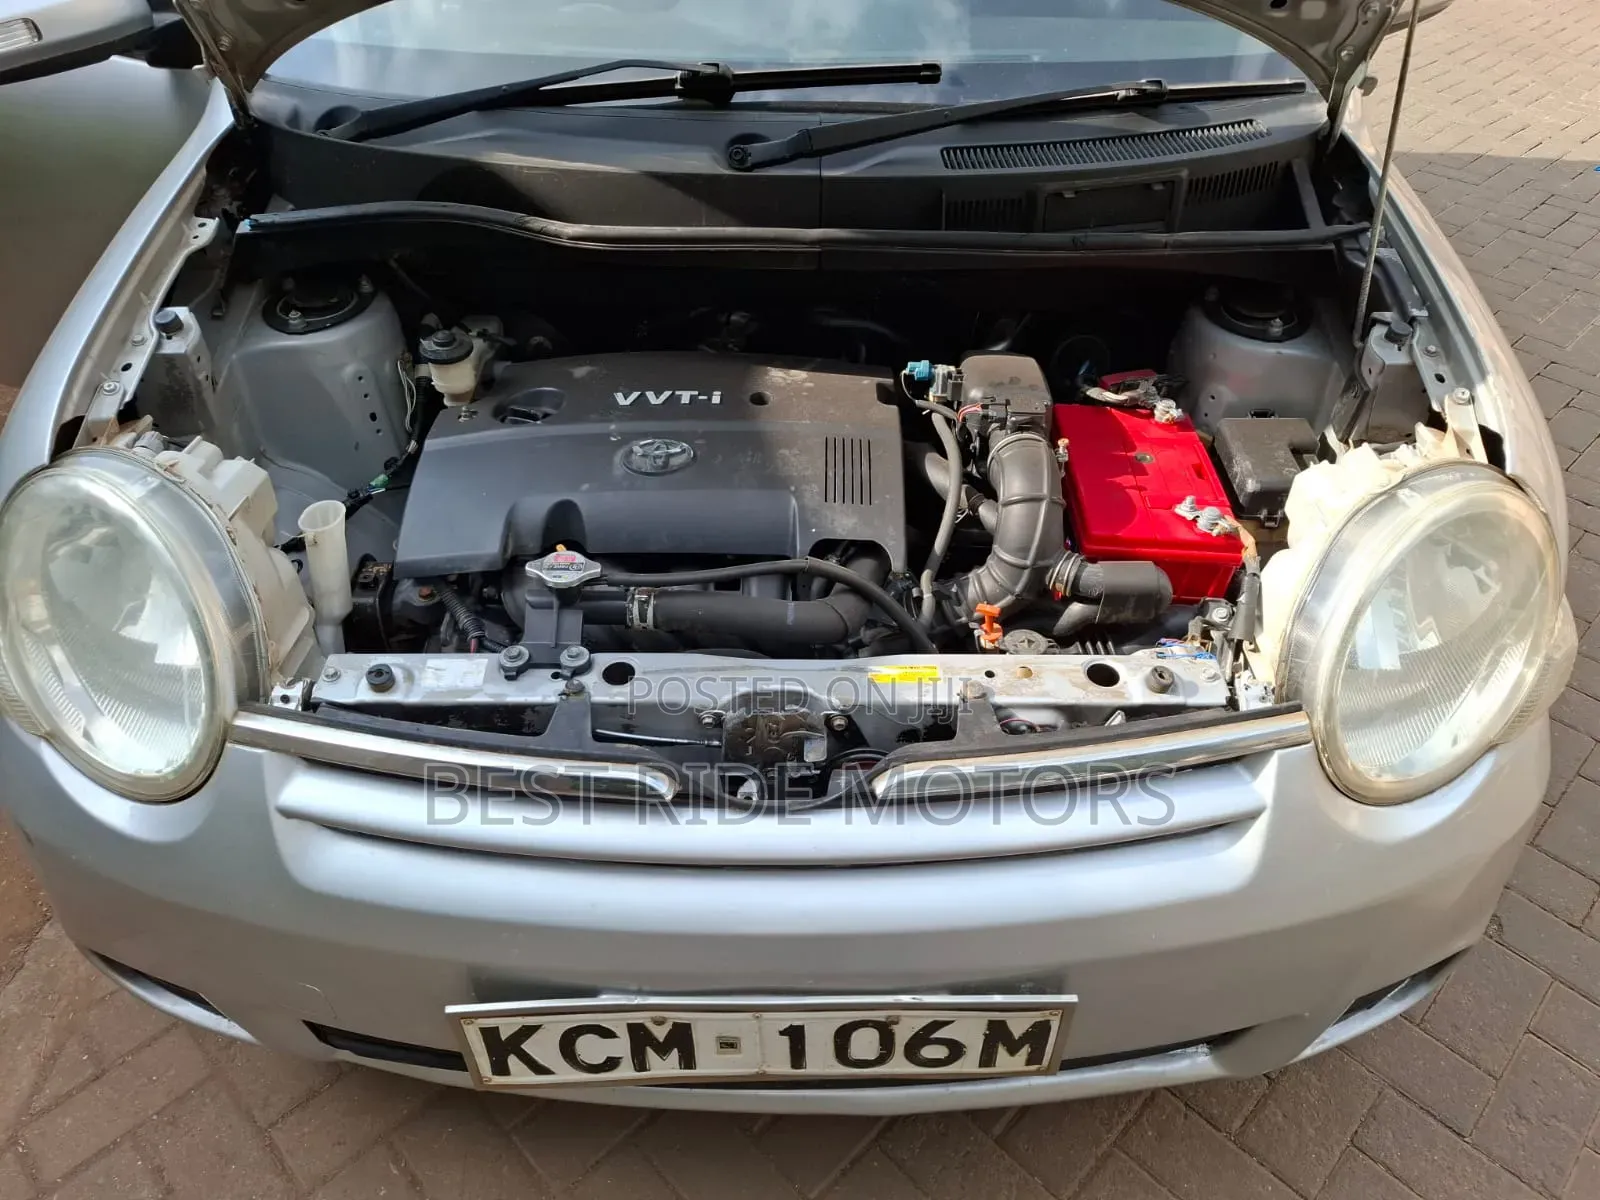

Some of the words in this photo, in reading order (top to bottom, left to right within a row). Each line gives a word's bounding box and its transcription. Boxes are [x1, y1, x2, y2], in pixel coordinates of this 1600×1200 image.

[613, 390, 722, 406] VVT-i
[478, 1020, 697, 1077] KCM
[777, 1018, 1053, 1070] 106M
